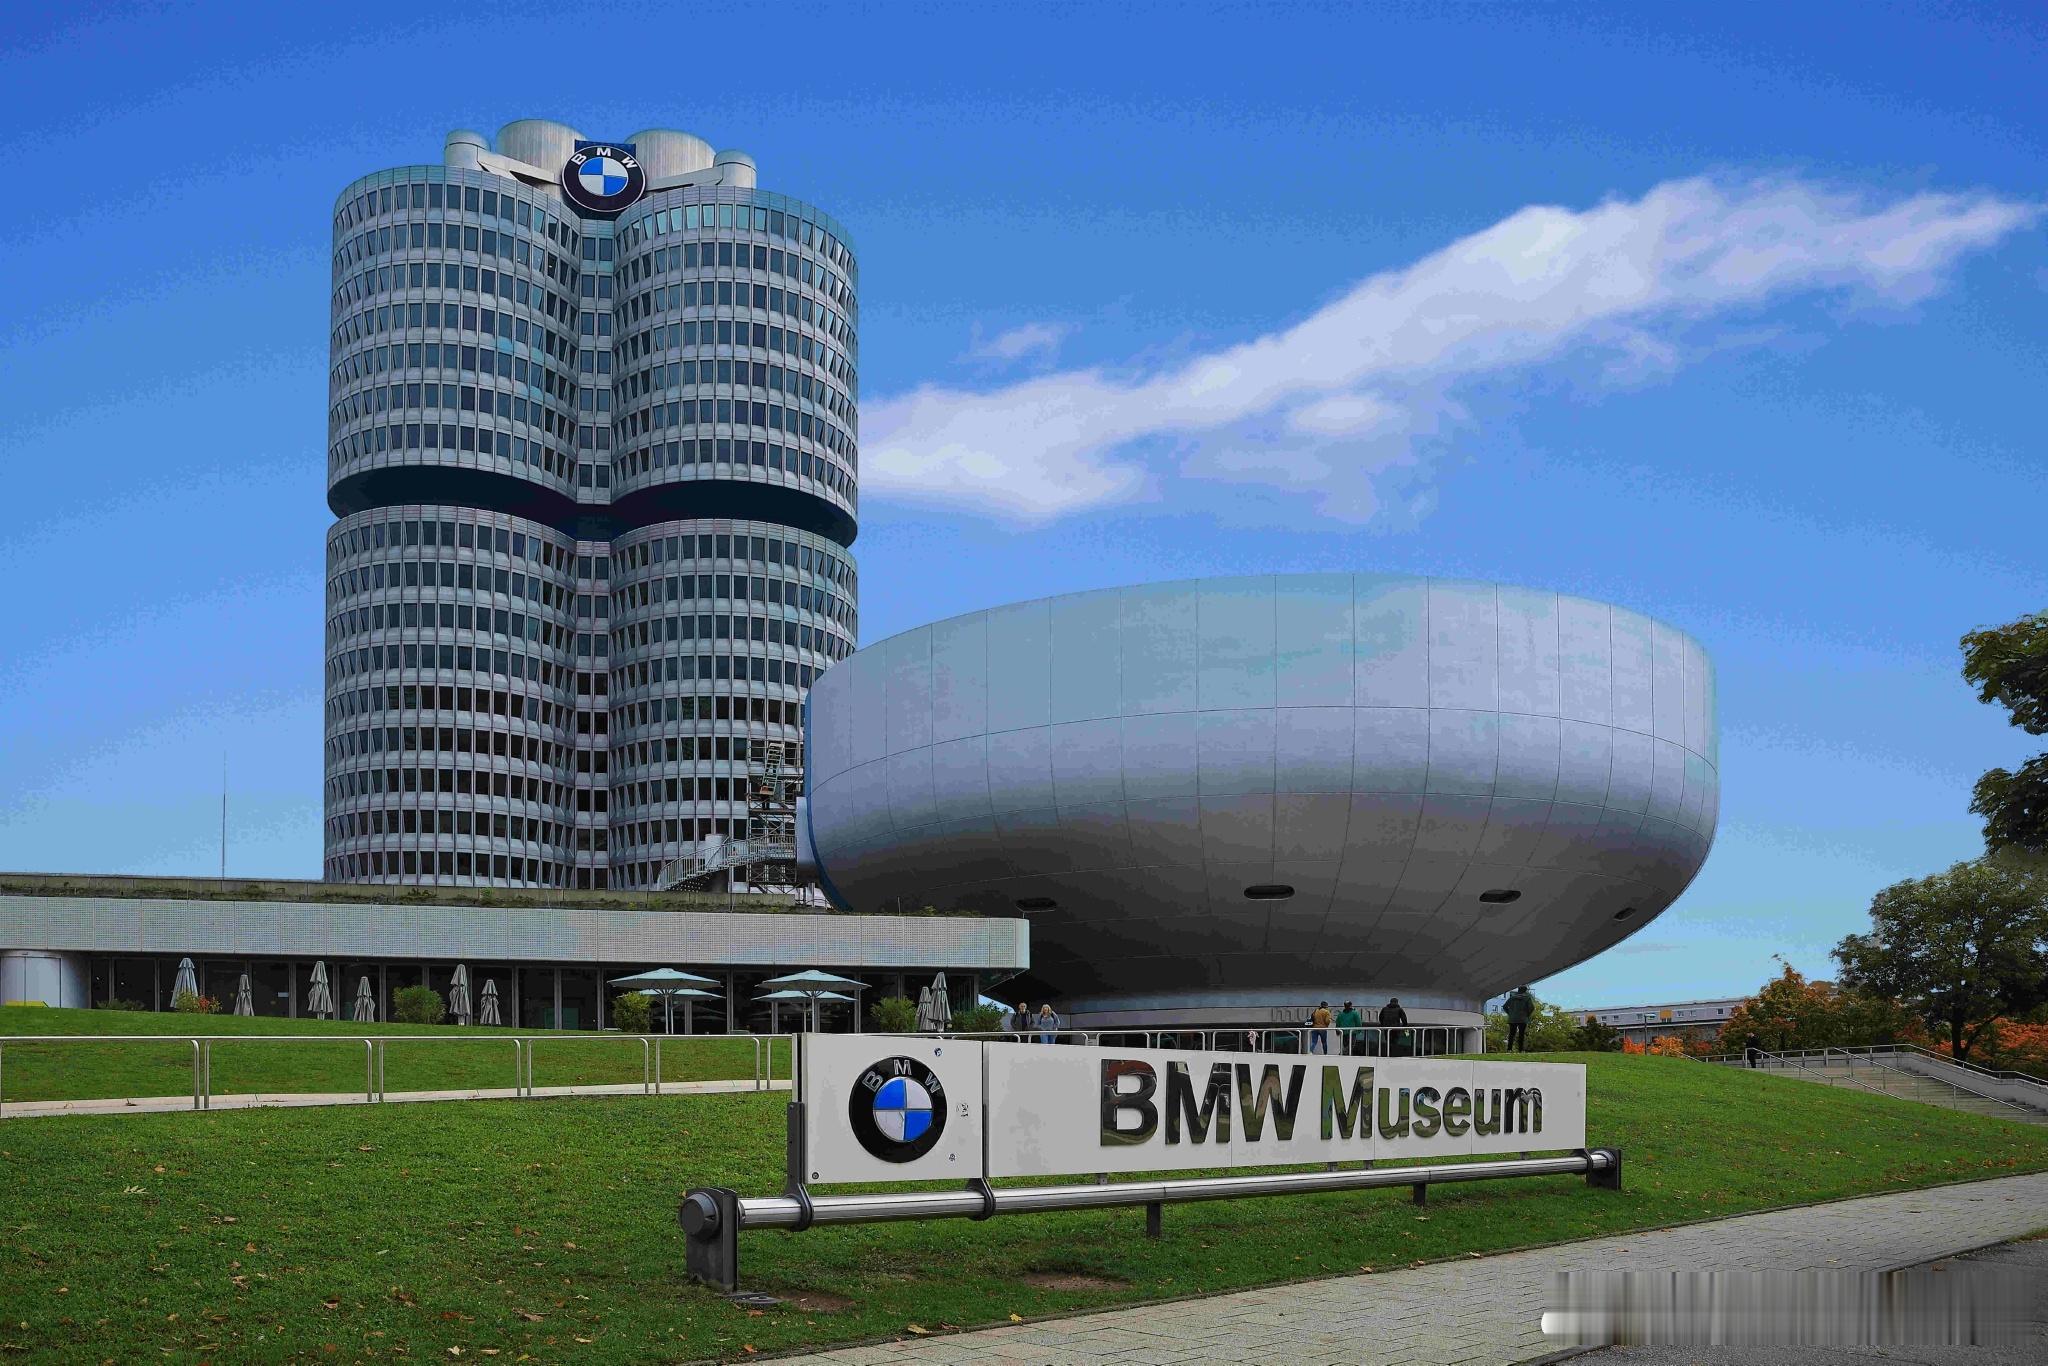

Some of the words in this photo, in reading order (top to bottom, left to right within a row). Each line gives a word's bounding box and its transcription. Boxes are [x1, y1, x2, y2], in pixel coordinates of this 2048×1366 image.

[571, 147, 638, 169] BMW
[862, 1059, 941, 1094] BMW
[1100, 1058, 1307, 1146] BMW
[1320, 1065, 1543, 1140] Museum
